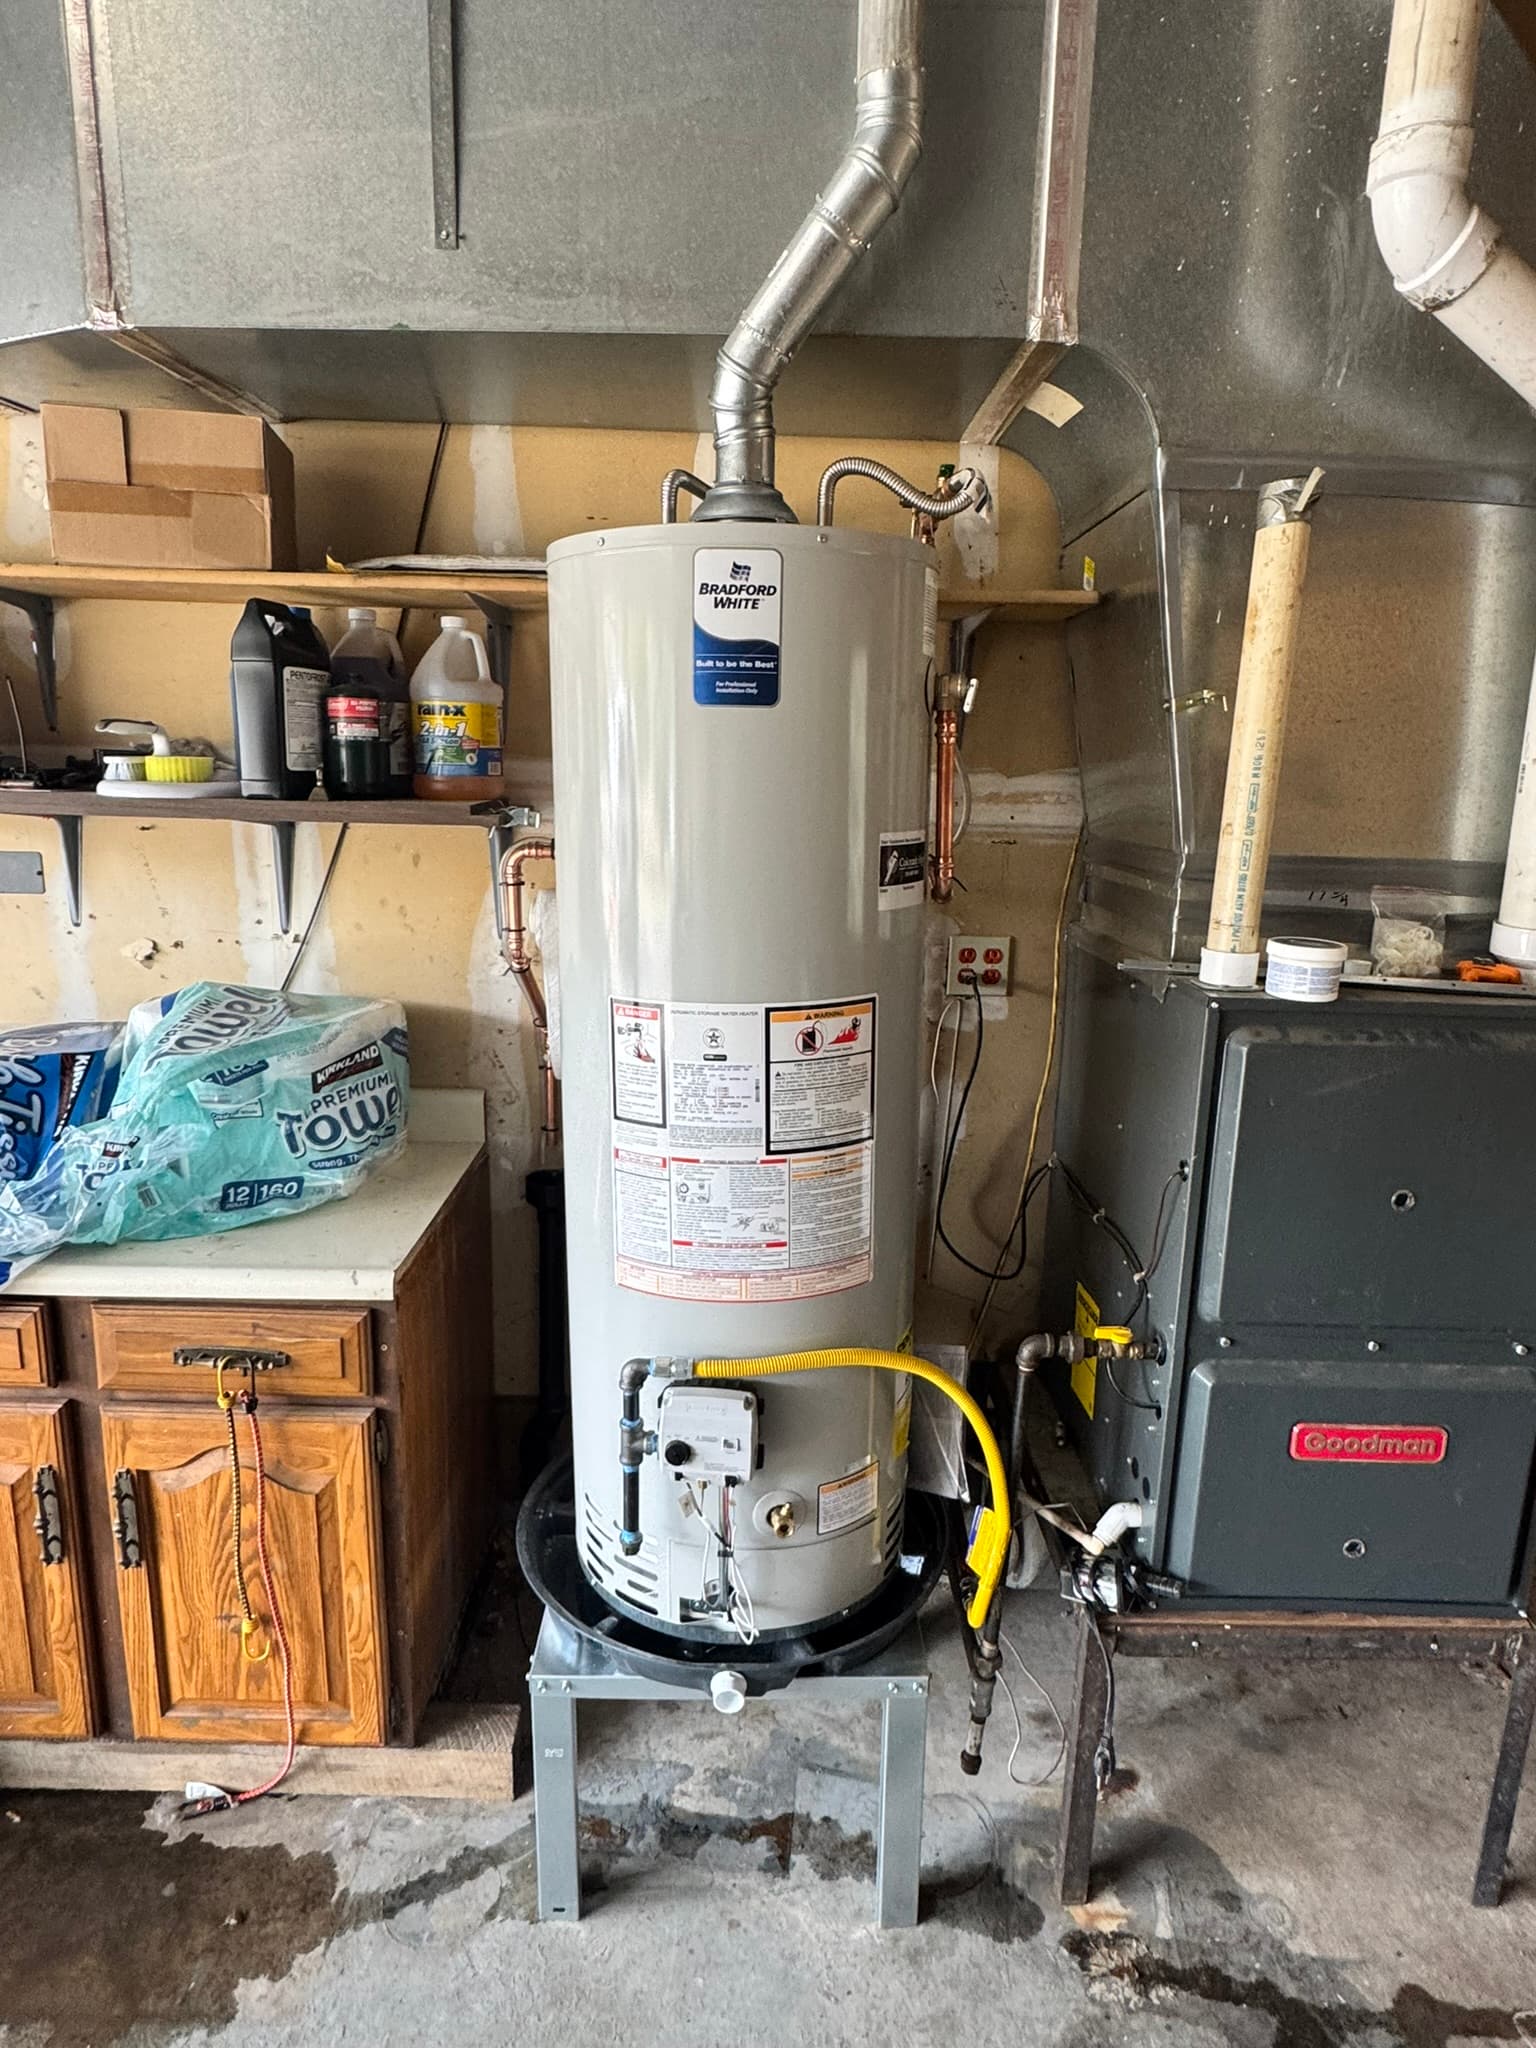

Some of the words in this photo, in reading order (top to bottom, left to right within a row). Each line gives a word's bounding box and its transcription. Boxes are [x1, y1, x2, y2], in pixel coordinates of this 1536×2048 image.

[699, 583, 777, 596] BRADFORD
[713, 597, 760, 609] WHITE
[726, 660, 738, 668] be
[739, 660, 753, 668] the
[420, 720, 467, 737] 2-in-1
[158, 998, 219, 1044] PREMIUM
[316, 1044, 380, 1084] KIRKLAND
[310, 1073, 389, 1113] PREMIUM
[277, 1086, 398, 1154] Towe
[227, 1186, 250, 1203] 12
[260, 1182, 298, 1200] 160
[1304, 1432, 1437, 1456] Goodman
